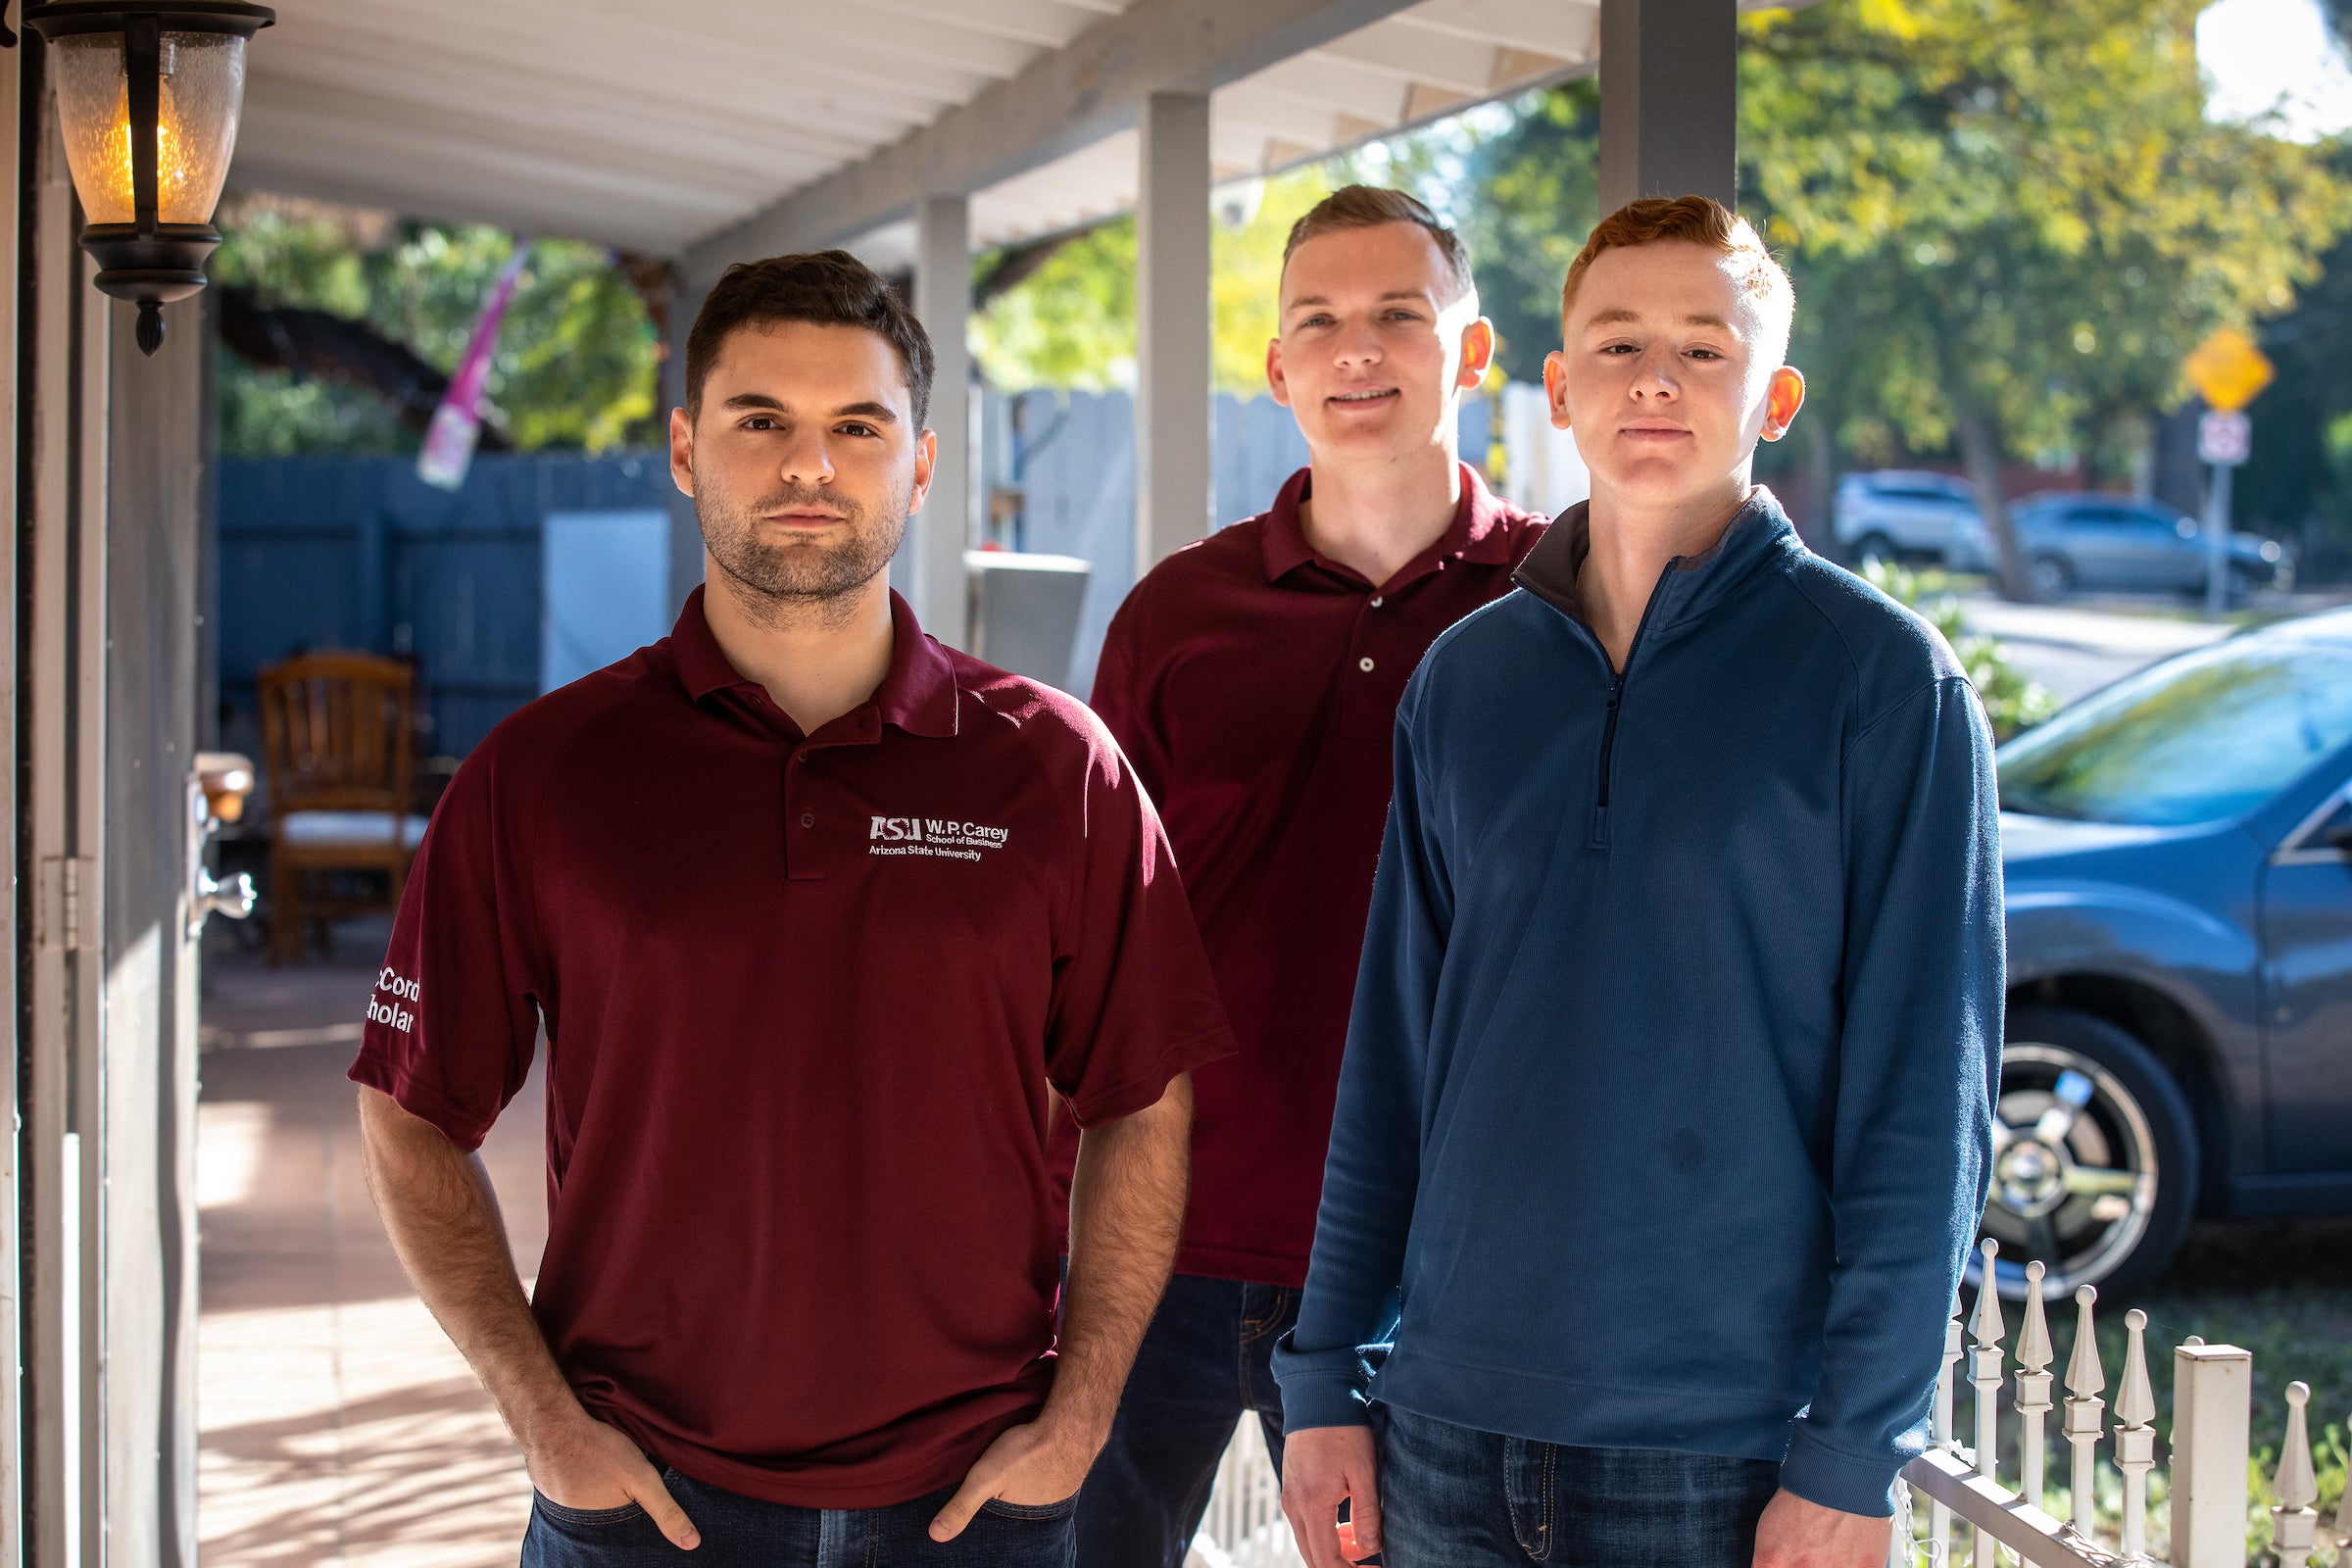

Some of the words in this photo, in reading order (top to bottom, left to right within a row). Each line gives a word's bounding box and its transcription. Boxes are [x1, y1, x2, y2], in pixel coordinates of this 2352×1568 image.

[869, 815, 923, 841] ASU
[962, 822, 1008, 843] Carey
[926, 833, 956, 845] School
[966, 837, 1003, 849] Business
[869, 845, 906, 856] Arizona
[907, 845, 934, 856] State
[935, 847, 982, 862] University
[367, 993, 415, 1033] holar
